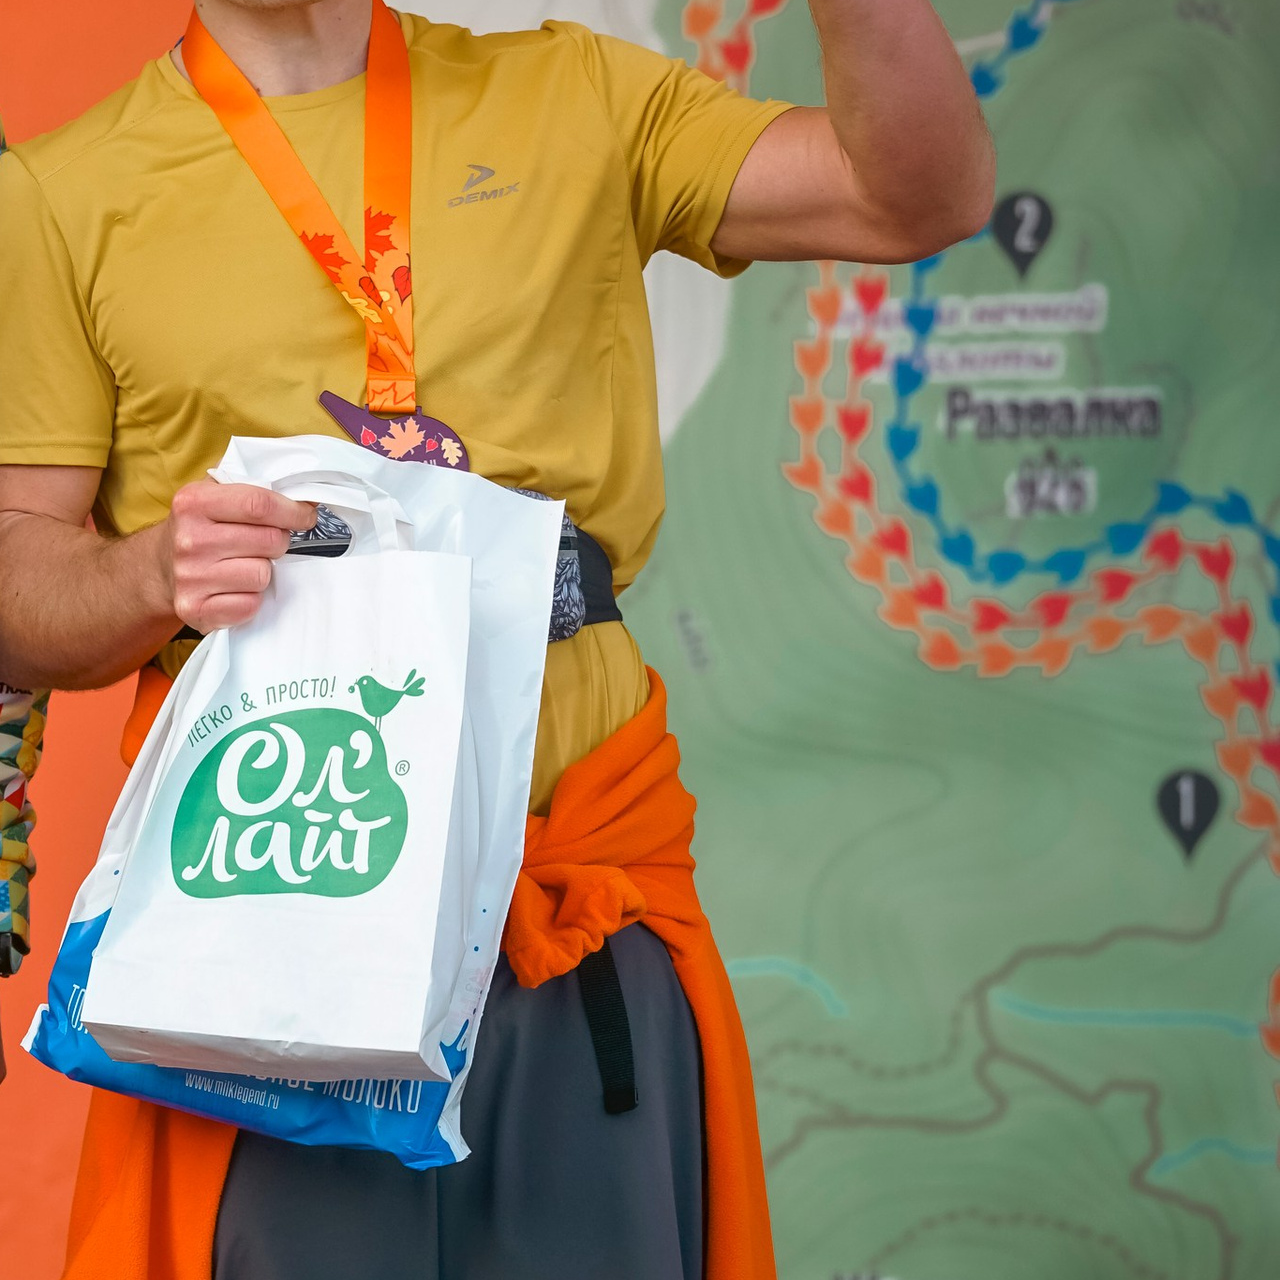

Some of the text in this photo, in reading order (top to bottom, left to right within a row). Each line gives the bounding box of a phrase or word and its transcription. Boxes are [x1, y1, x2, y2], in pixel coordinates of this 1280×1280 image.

[447, 181, 520, 209] DEMIX
[1014, 197, 1041, 253] 2
[187, 676, 336, 747] ЛЕГКО & ПРОСТО!
[1176, 775, 1195, 830] 1
[181, 808, 392, 885] лайт
[184, 1072, 280, 1110] www.milklegend.ru
